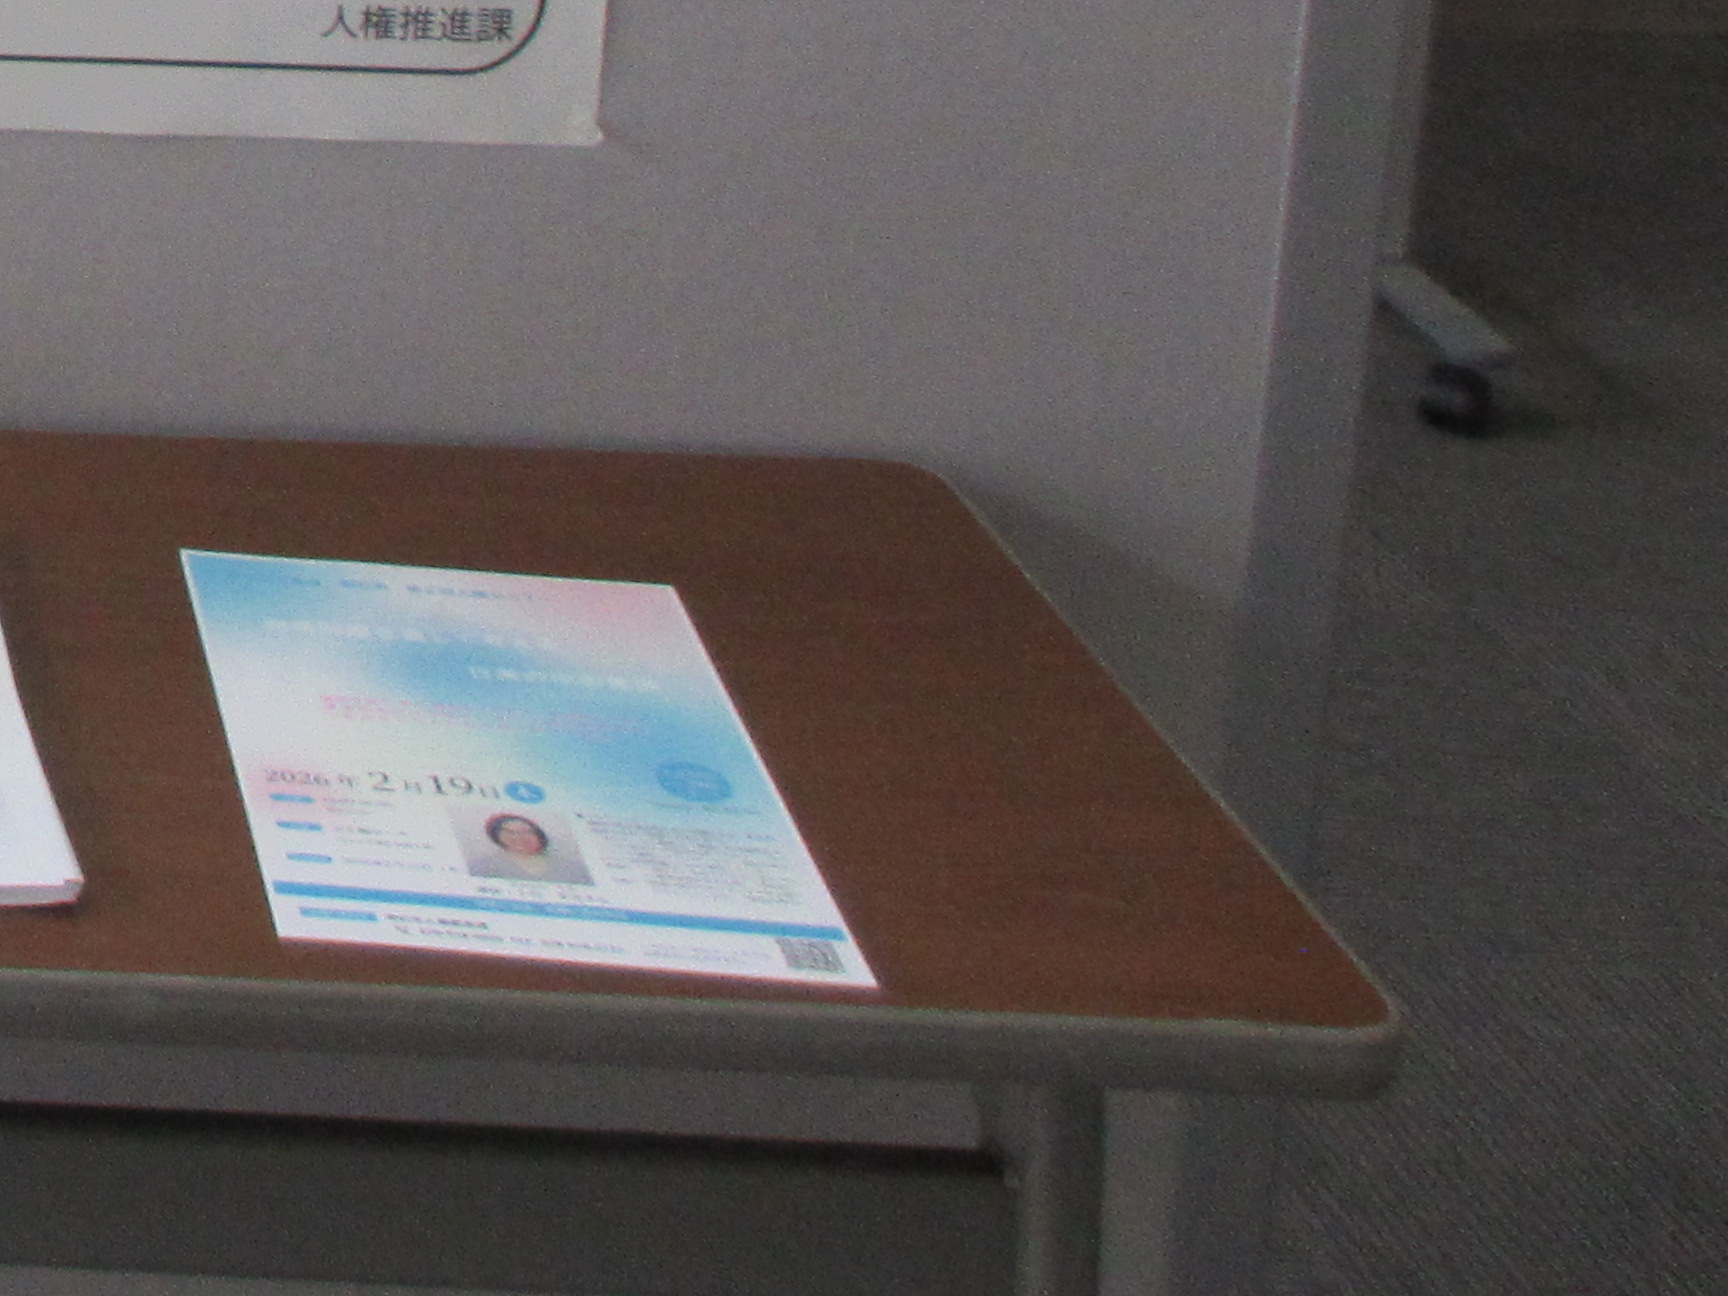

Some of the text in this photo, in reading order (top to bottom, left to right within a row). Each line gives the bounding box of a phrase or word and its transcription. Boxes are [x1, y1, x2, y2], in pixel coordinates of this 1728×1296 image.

[320, 4, 516, 46] 人権推進課
